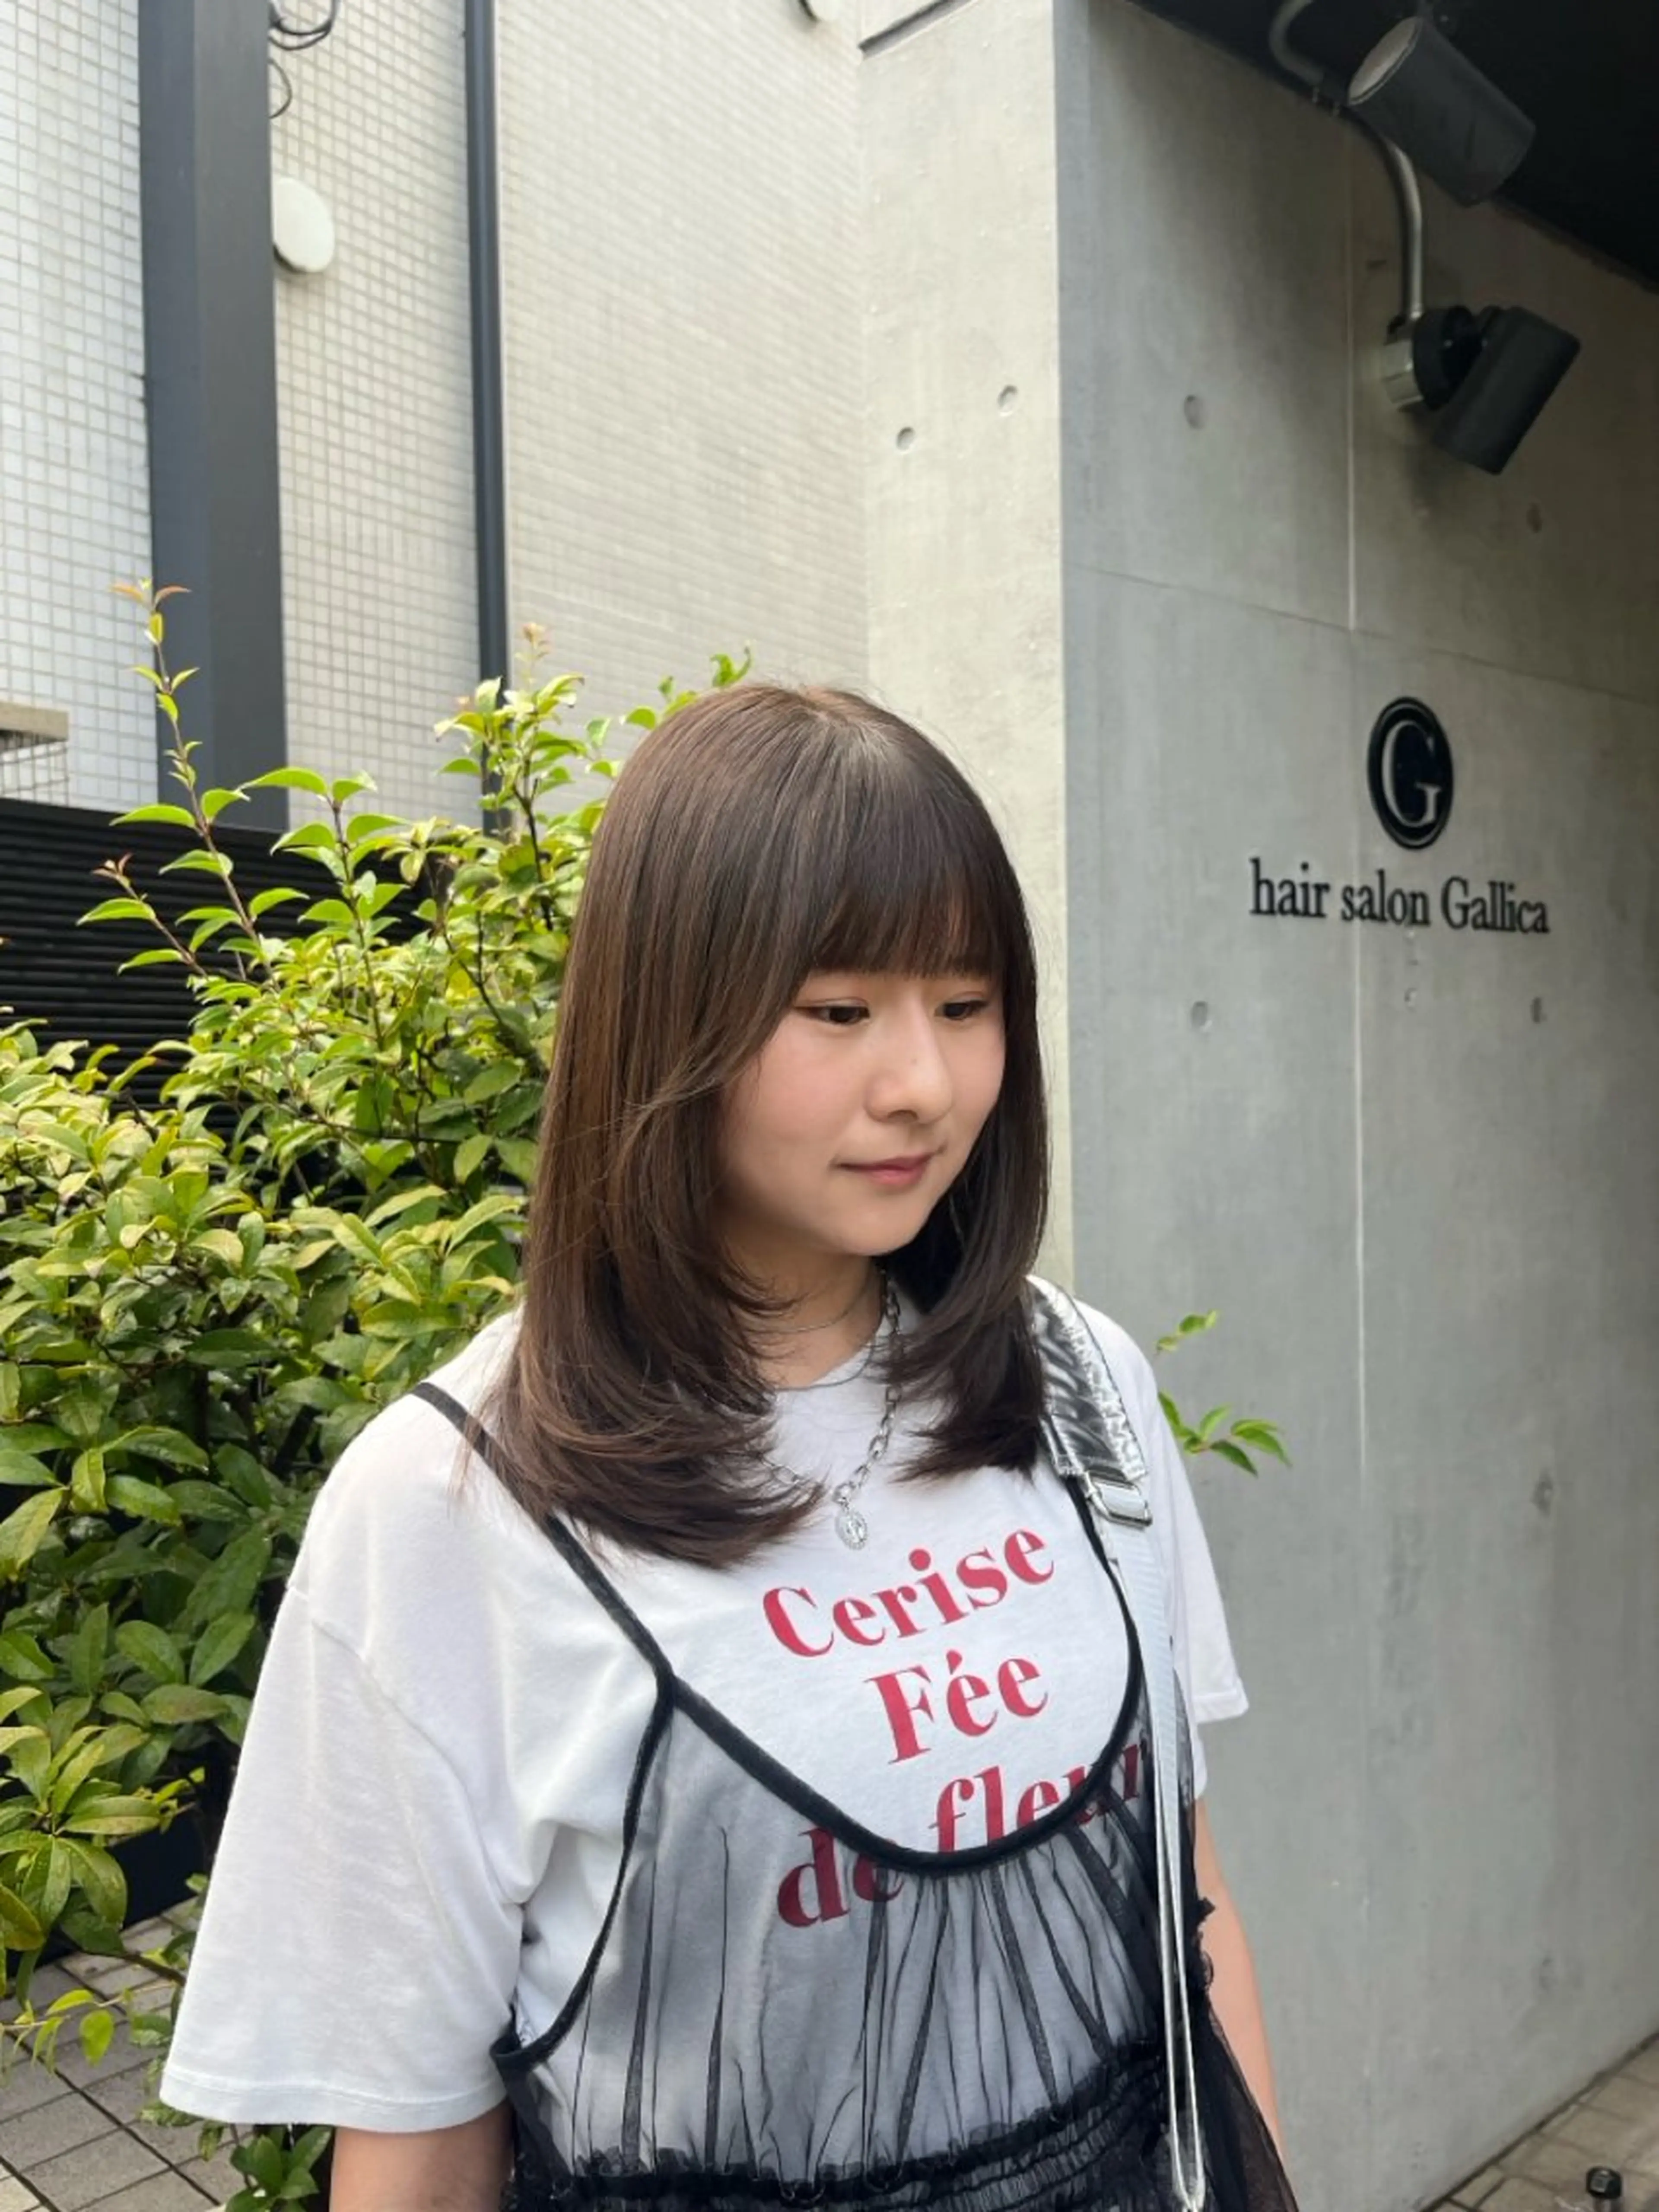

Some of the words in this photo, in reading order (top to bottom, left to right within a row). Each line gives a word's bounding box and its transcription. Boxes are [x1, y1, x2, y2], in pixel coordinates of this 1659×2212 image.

[1381, 719, 1442, 828] G
[1249, 856, 1331, 918] hair
[1341, 868, 1431, 927] salon
[1440, 875, 1550, 934] Gallica
[762, 1528, 1054, 1657] Cerise
[864, 1649, 1049, 1764] Fée
[777, 1826, 905, 1928] de
